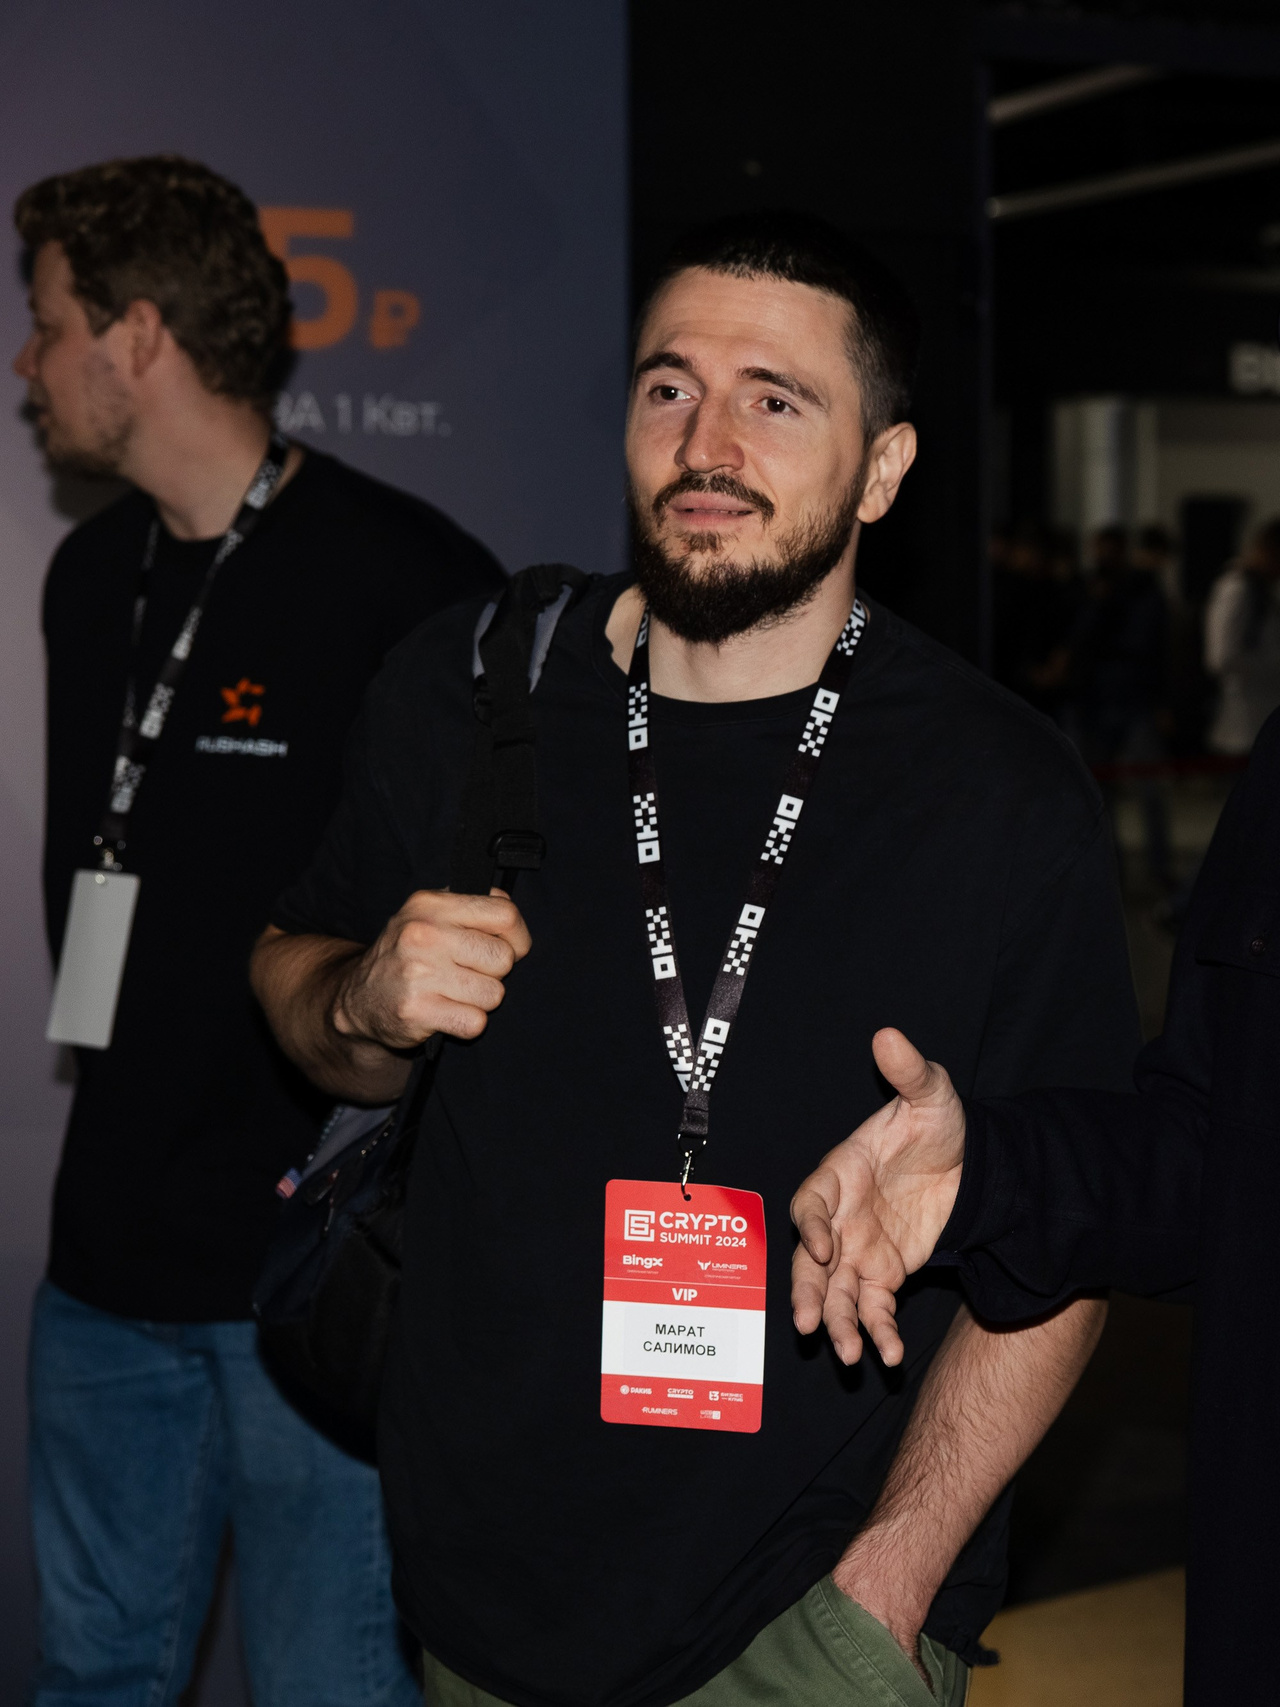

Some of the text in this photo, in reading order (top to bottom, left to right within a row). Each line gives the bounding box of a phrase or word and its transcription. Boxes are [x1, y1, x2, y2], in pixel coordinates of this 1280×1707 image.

[337, 394, 352, 434] 1
[628, 682, 648, 751] OKX
[798, 687, 840, 757] OKX
[633, 792, 660, 864] OKX
[760, 794, 804, 864] OKX
[645, 906, 677, 980] OKX
[723, 903, 766, 976] OKX
[691, 1017, 730, 1092] OKX
[659, 1211, 748, 1233] CRYPTO
[660, 1232, 747, 1247] SUMMIT 2024
[672, 1288, 698, 1301] VIP
[643, 1341, 716, 1356] САЛИМОВ
[655, 1323, 705, 1337] МАРАТ
